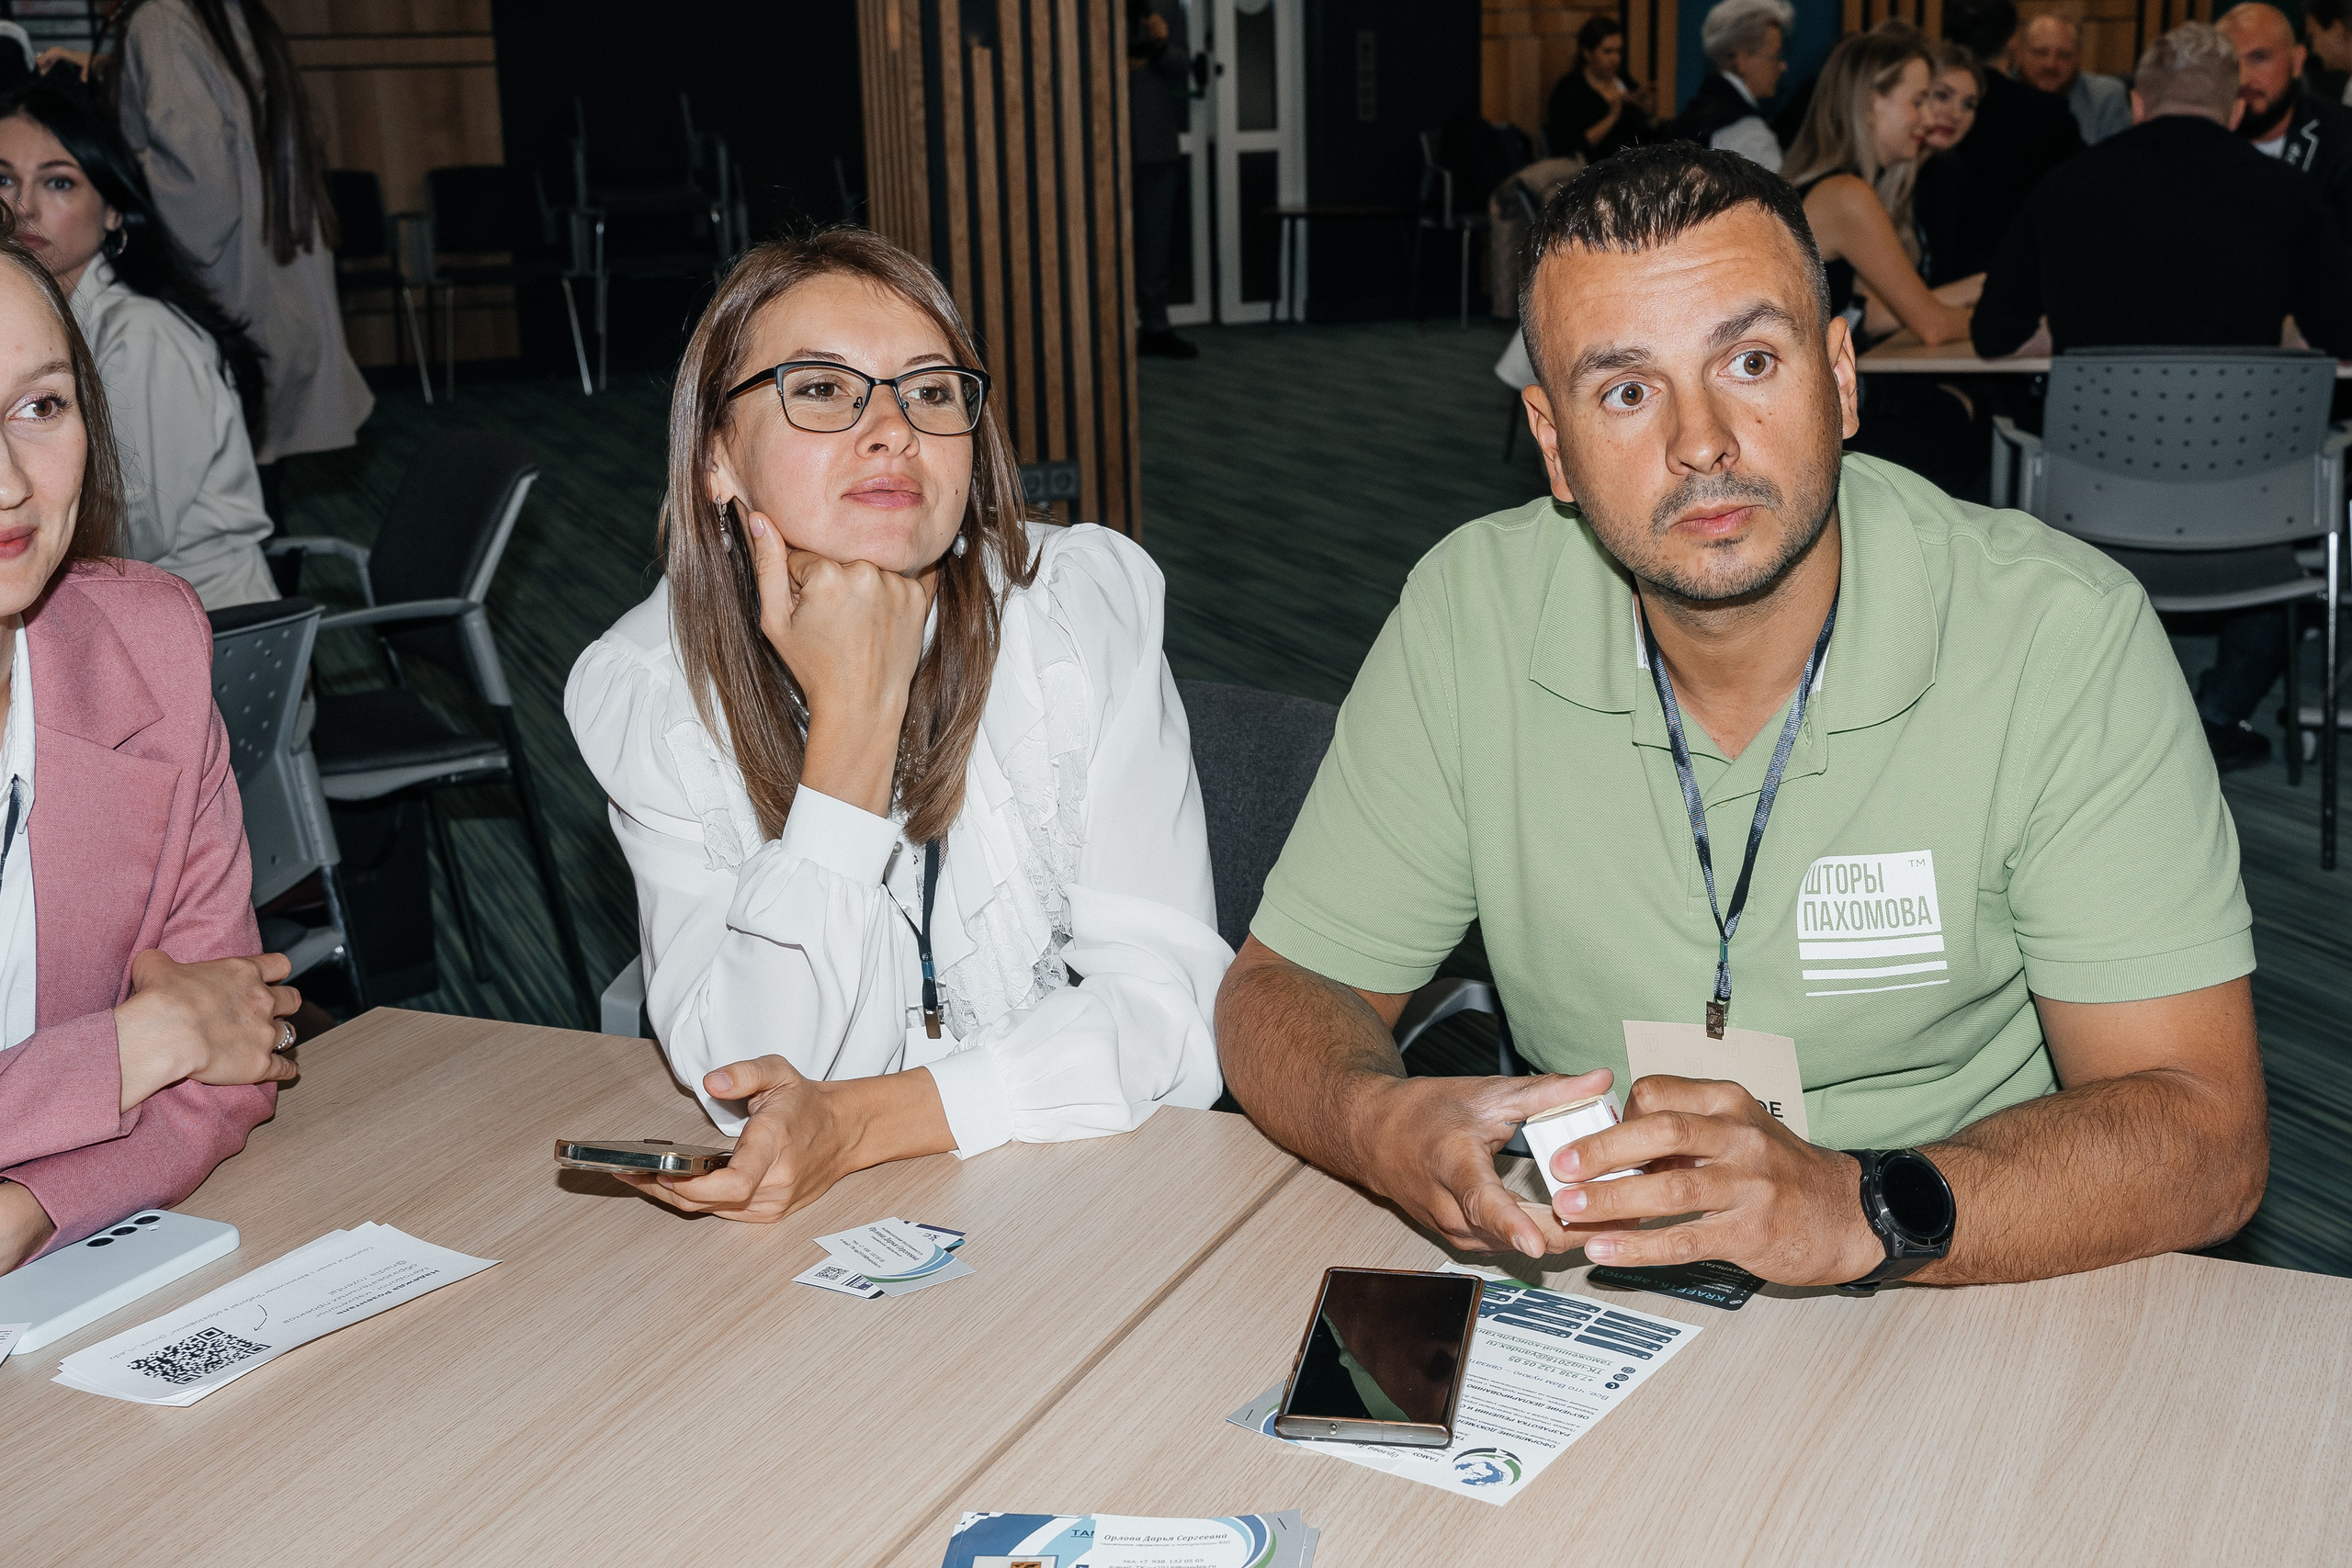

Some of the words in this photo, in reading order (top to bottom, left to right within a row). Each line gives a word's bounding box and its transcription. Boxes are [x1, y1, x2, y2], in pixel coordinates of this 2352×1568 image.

[1804, 862, 1884, 895] ШТОРЫ
[1804, 895, 1933, 931] ПАХОМОВА
[1699, 1260, 1750, 1275] РЕЗУЛЬТАТ
[391, 1269, 440, 1291] Надежда
[313, 1290, 373, 1317] маркетолог
[334, 1289, 392, 1315] Розенталь
[280, 1300, 332, 1324] проектов
[1511, 1370, 1544, 1381] нужно
[1536, 1364, 1558, 1372] 132
[1557, 1370, 1579, 1378] 938
[1543, 1379, 1567, 1388] Вам
[1464, 1383, 1545, 1406] ДЕКЛАРИРОВАНИЮ
[1585, 1391, 1611, 1400] Все,
[1472, 1407, 1516, 1422] РЕШЕНИЙ
[1544, 1404, 1590, 1419] ОБУЧЕНИЕ
[1454, 1418, 1498, 1432] ДОКУМЕН
[1514, 1419, 1571, 1437] РАЗРАБОТКА
[1497, 1430, 1557, 1448] ОФОРМЛЕНИЕ
[1104, 1533, 1141, 1543] Орлова
[1142, 1533, 1174, 1543] Дарья
[1177, 1532, 1227, 1543] Сергеевна
